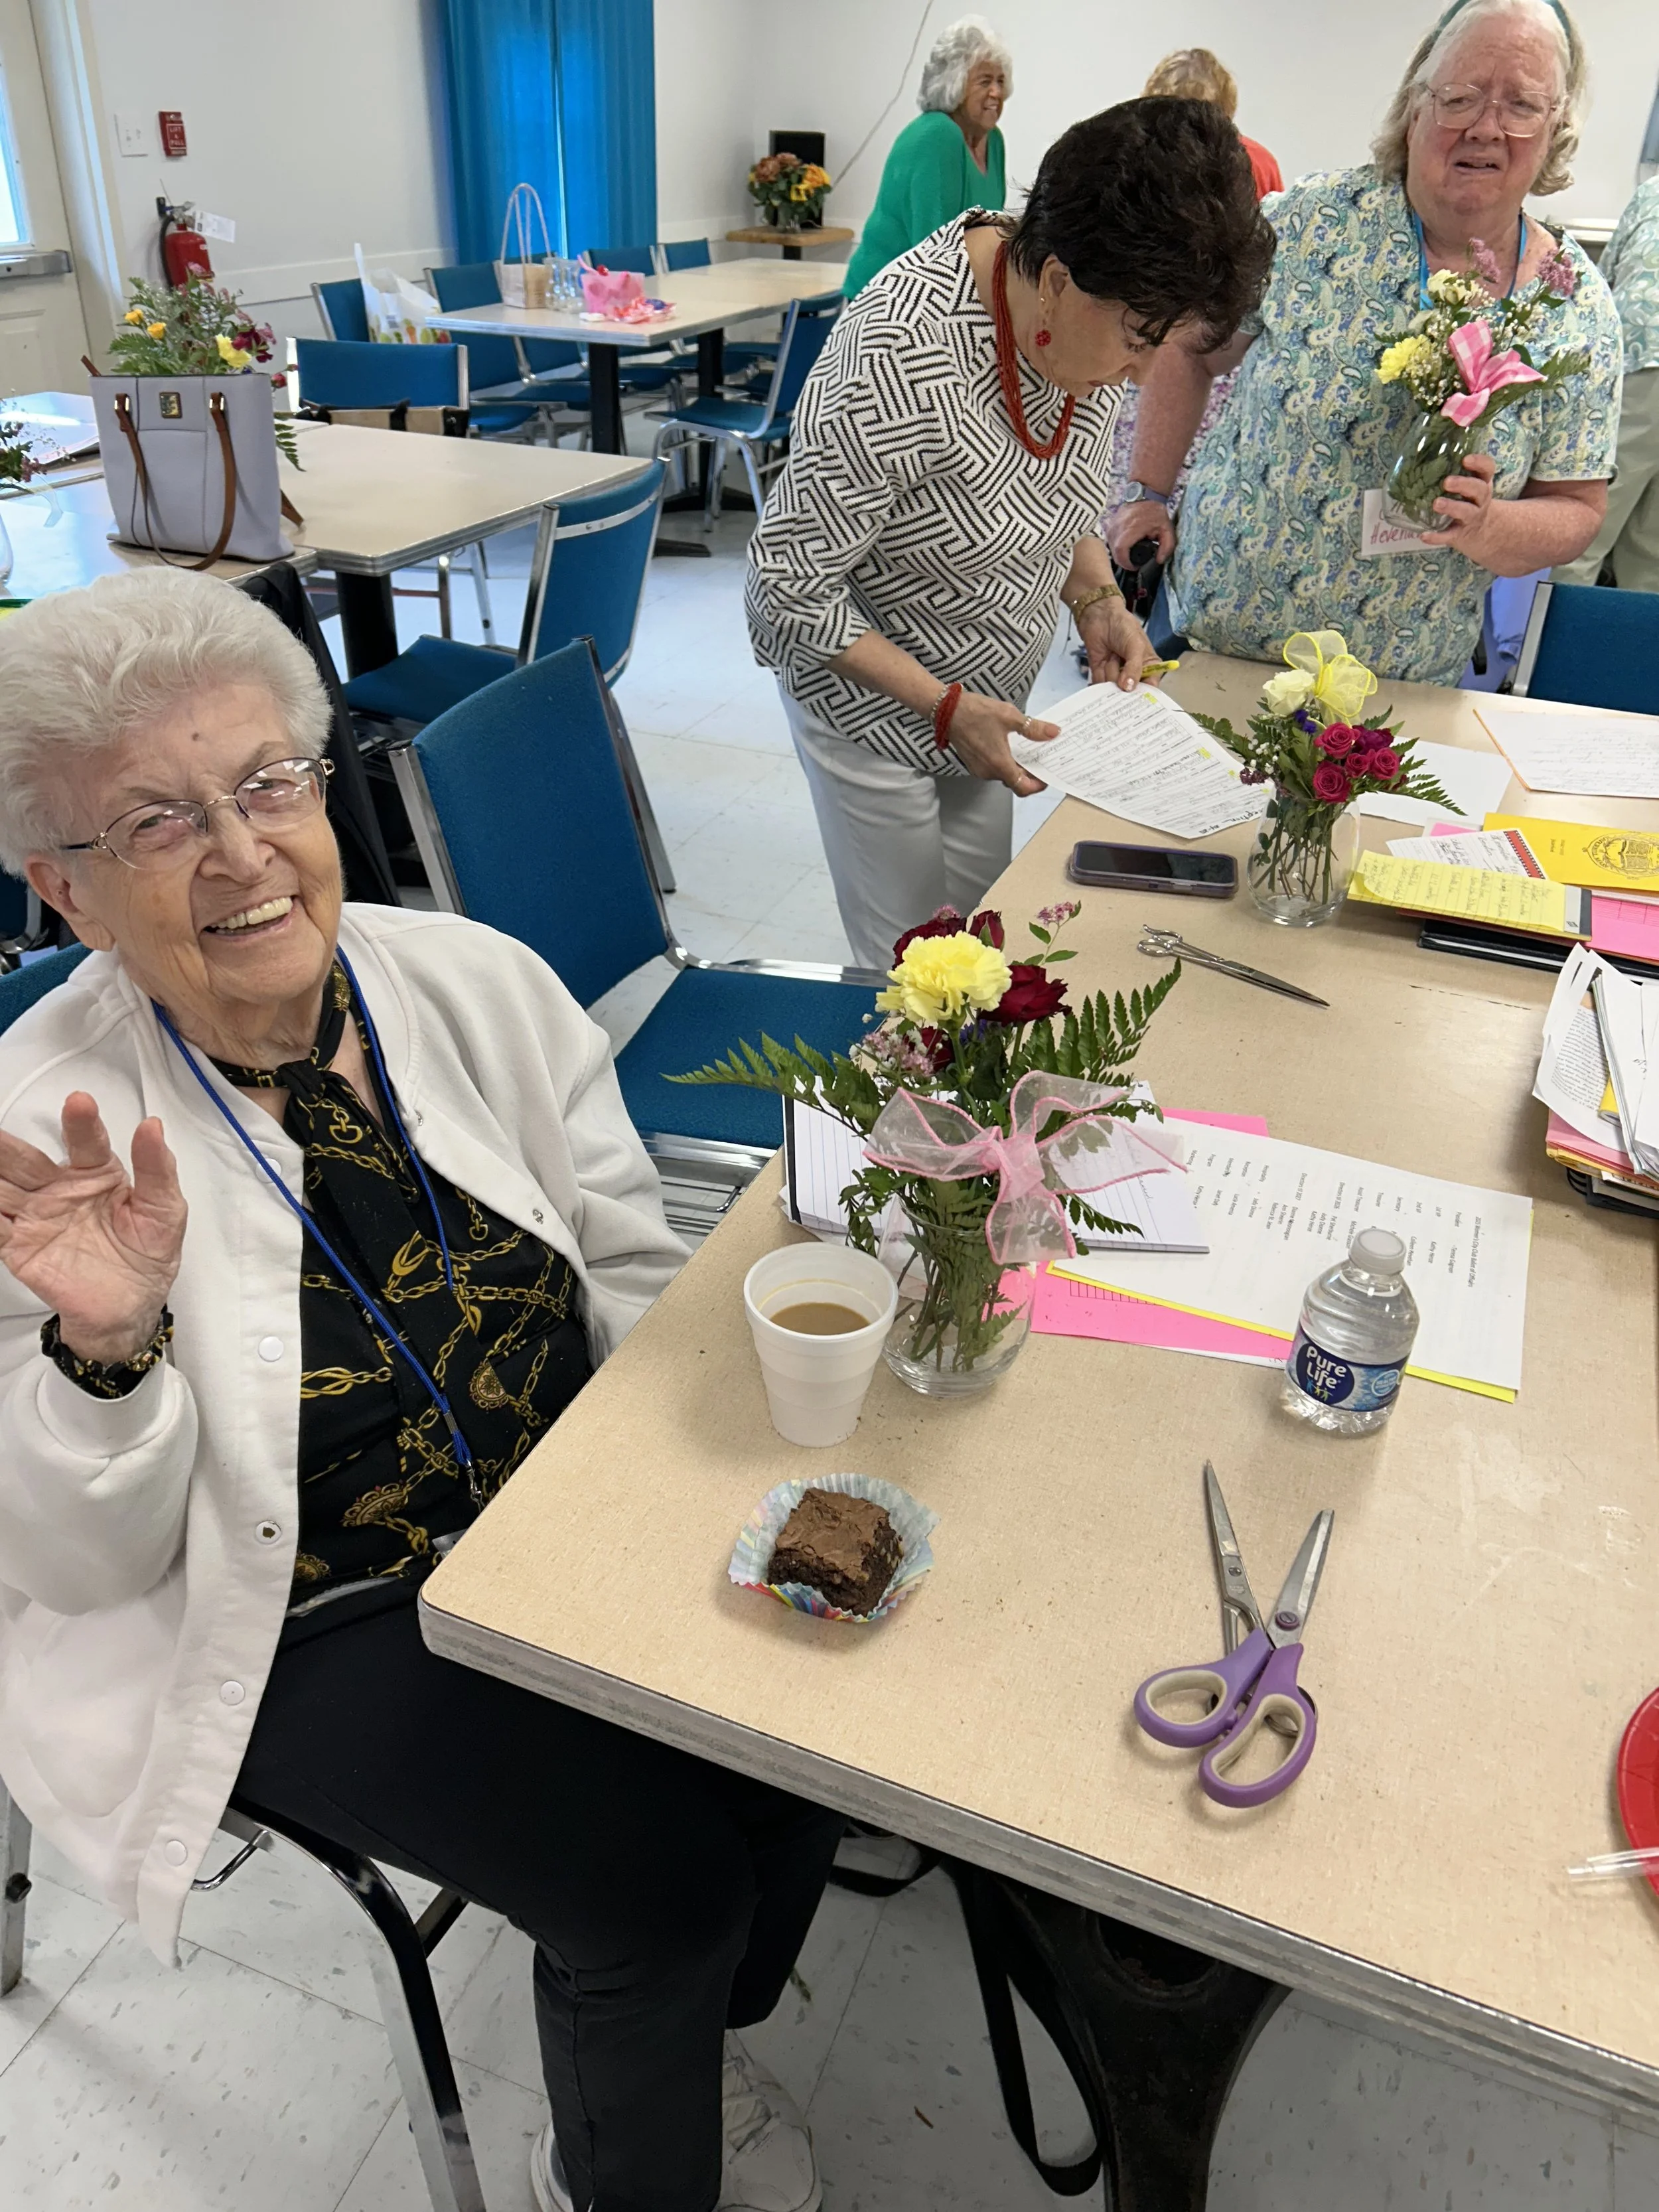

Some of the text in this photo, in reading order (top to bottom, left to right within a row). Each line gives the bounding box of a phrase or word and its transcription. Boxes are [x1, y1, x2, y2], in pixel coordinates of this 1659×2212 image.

[1186, 1150, 1198, 1165] Marketing
[1207, 1154, 1216, 1167] Program
[1242, 1161, 1251, 1177] Reception
[1299, 1173, 1307, 1187] Directors
[1336, 1182, 1345, 1196] Directors
[1306, 1345, 1346, 1378] Pure
[1306, 1362, 1338, 1388] Life
